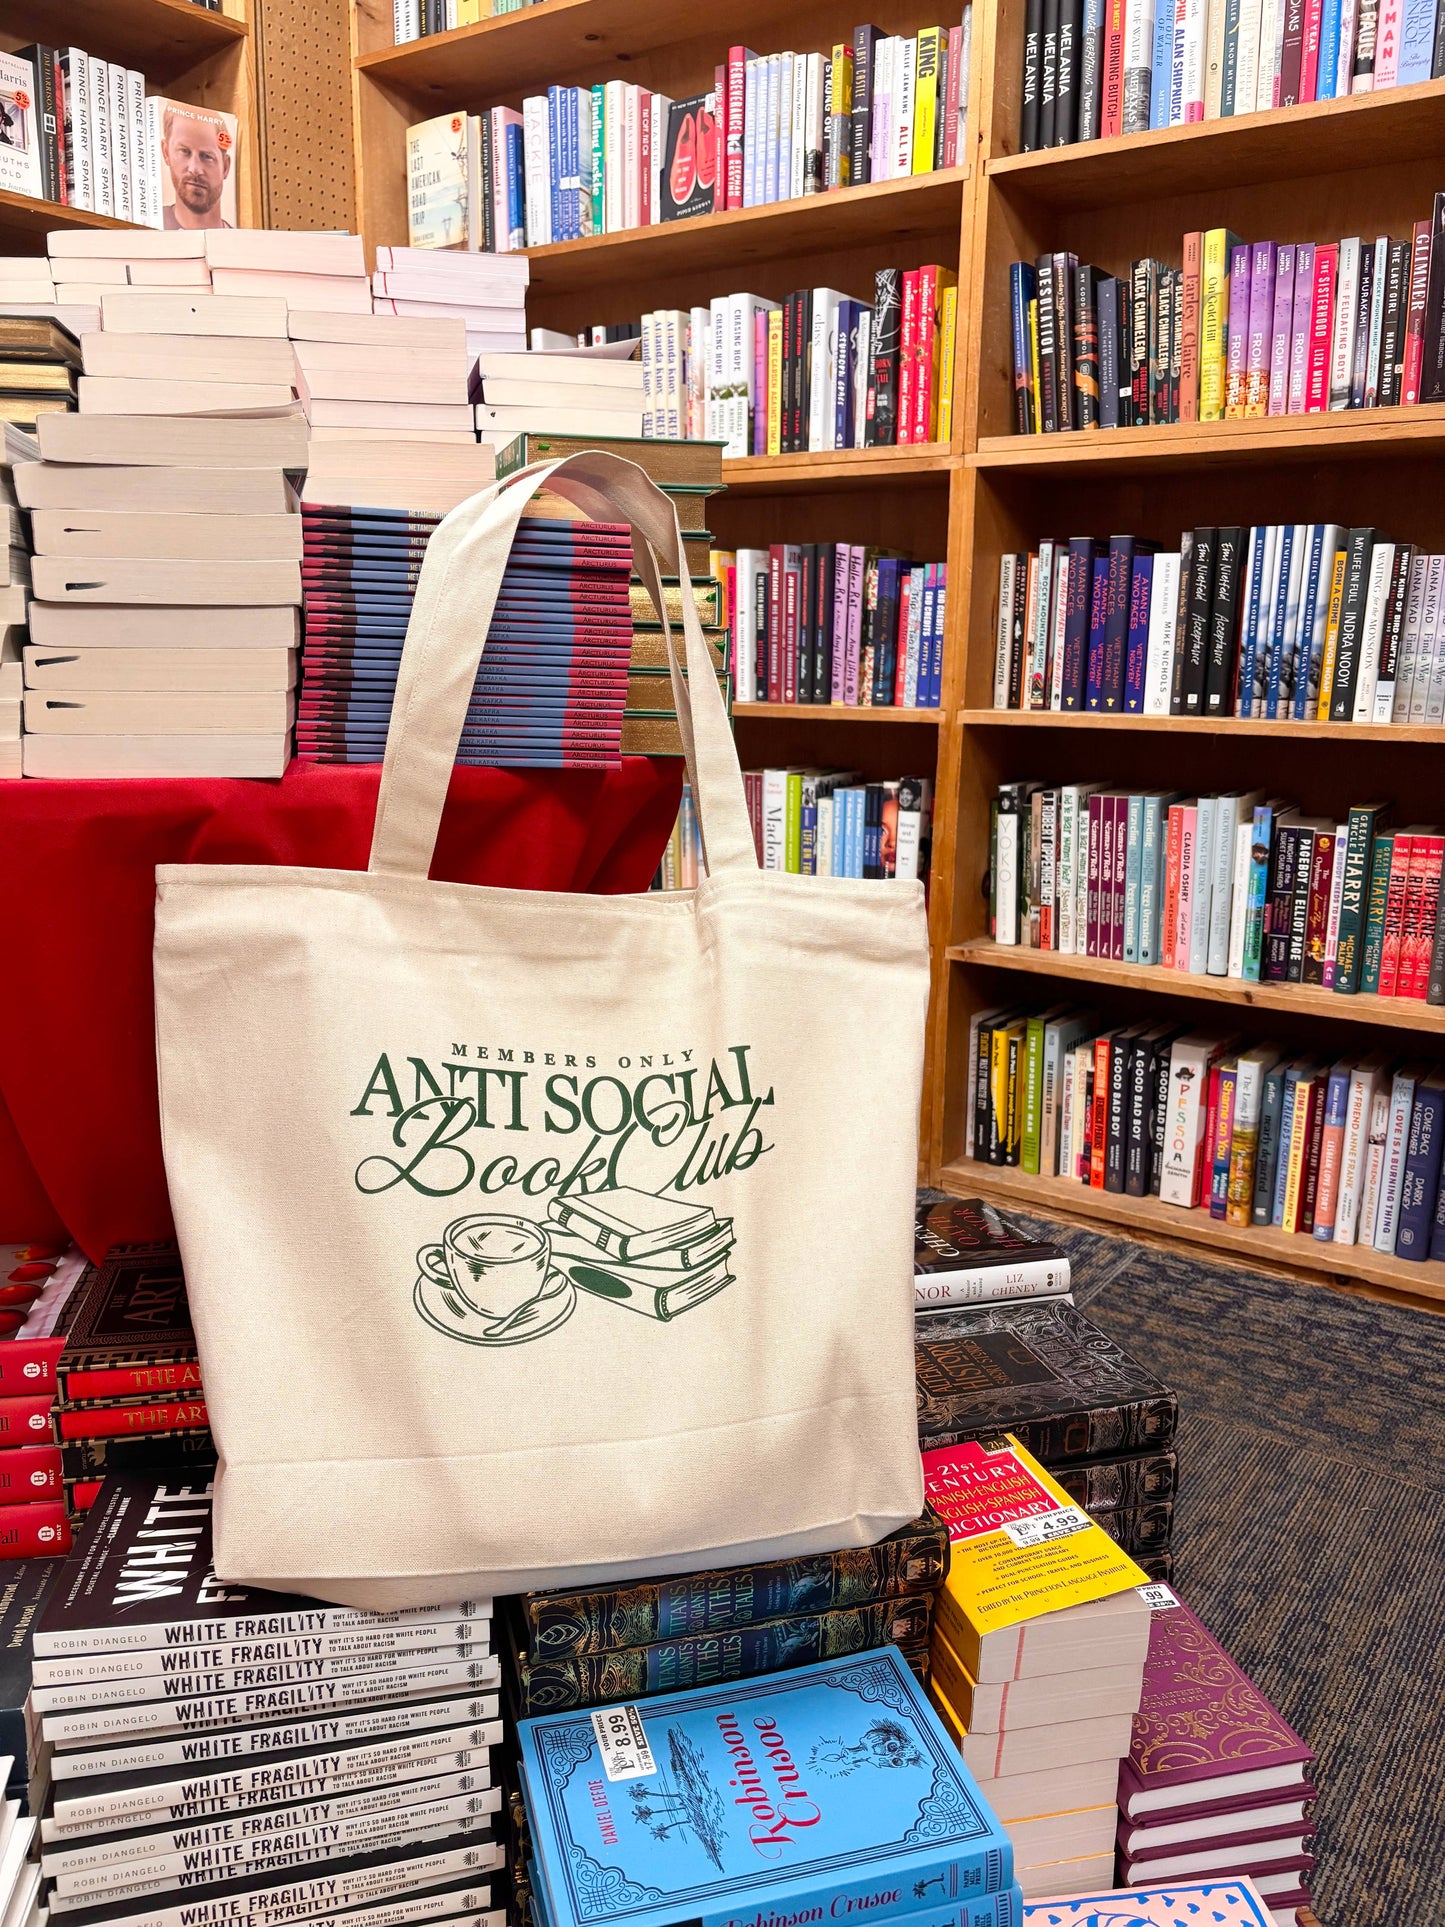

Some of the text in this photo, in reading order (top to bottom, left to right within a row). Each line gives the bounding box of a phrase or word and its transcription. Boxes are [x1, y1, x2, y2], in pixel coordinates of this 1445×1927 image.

[858, 46, 867, 68] LAST
[918, 34, 937, 79] KING
[1024, 32, 1038, 105] MELANIA
[1042, 32, 1056, 106] MELANIA
[1058, 24, 1072, 98] MELANIA
[1107, 34, 1120, 118] BURNING BUTCH
[1170, 28, 1186, 121] ALAN SHIPNUCK
[729, 61, 744, 138] PERSEVERANCE
[855, 70, 866, 98] CASTLE
[77, 57, 90, 199] PRINCE HARRY SPARE
[166, 105, 225, 126] PRINCE HARRY
[899, 126, 908, 150] ALL
[898, 153, 906, 168] IN
[1410, 234, 1431, 312] GLIMMER
[1038, 268, 1054, 356] DESOLATION
[1134, 268, 1146, 362] BLACK CHAMELEON
[1338, 294, 1350, 348] FELDAFING
[1358, 277, 1370, 328] MURAKAMI
[1382, 246, 1401, 396] THE LAST GIRL NADIA MURAD
[1312, 260, 1330, 399] THE SISTERHOOD LIZA MUNDY
[1229, 335, 1242, 404] FROM HERE
[1336, 351, 1347, 380] BOYS
[583, 548, 619, 556] ARCTURUS
[1198, 543, 1210, 561] Emi
[1336, 560, 1344, 586] BORN
[1348, 537, 1364, 604] MY LIFE IN FULL
[834, 552, 847, 606] Holler Rat
[1408, 558, 1424, 624] DIANA NYAD
[998, 560, 1012, 685] SAVING FIVE AMANDA NGUYEN
[1330, 596, 1340, 624] CRIME
[1386, 552, 1410, 674] WHAT KIND OF BIRD CAN'T FLY
[1160, 621, 1172, 694] MIKE NICHOLS
[1190, 613, 1206, 666] Acceptance
[1337, 612, 1356, 688] INDRA NOOYI
[1358, 815, 1368, 852] GREAT-
[1182, 832, 1192, 902] CLAUDIA OSHRY
[1342, 817, 1364, 914] UNCLE HARRY
[1290, 838, 1312, 961] PAGEBOY ELLIOT PAGE
[1384, 876, 1406, 938] RIVERINE
[1338, 942, 1346, 966] PALIN
[1343, 934, 1355, 974] MICHAEL
[450, 1042, 696, 1069] MEMBERS ONLY
[350, 1044, 775, 1136] ANTI SOCIAL
[1110, 1046, 1124, 1138] A GOOD BAD BOY
[1216, 1080, 1234, 1160] Shame on You
[1345, 1080, 1364, 1190] MY FRIEND ANNE FRANK
[1394, 1108, 1405, 1134] LOVE
[1394, 1136, 1402, 1148] IS
[1408, 1101, 1423, 1156] IN SEPTEMBER
[1419, 1106, 1435, 1156] COME BACK
[355, 1096, 776, 1198] Book Club
[1386, 1158, 1399, 1202] BURNING
[1402, 1170, 1414, 1210] PINCKNEY
[1412, 1177, 1424, 1206] DARRYL
[1382, 1202, 1394, 1234] THING
[991, 1283, 1038, 1297] CHENEY
[1006, 1273, 1024, 1284] LIZ
[130, 1368, 176, 1389] THE
[924, 1462, 1018, 1494] ENTURY
[936, 1462, 976, 1476] 21ST
[1034, 1507, 1075, 1522] YOUR PRICE
[1043, 1514, 1080, 1531] 4.99
[112, 1486, 214, 1606] WHITE
[977, 1602, 1002, 1614] EDITED
[1002, 1598, 1010, 1606] BY
[1023, 1582, 1062, 1600] PRINCETON
[1062, 1574, 1098, 1587] LANGUAGE
[1098, 1564, 1128, 1578] INSTITUTE
[53, 1612, 326, 1650] ROBIN DIANGELO WHITE FRAGILITY
[416, 1628, 437, 1636] PEOPLE
[49, 1638, 323, 1678] ROBIN DIANGELO WHITE FRAGILITY
[595, 1714, 610, 1751] YOUR PRICE
[608, 1714, 631, 1747] 8.99
[716, 1712, 797, 1860] Robinson
[752, 1715, 822, 1828] Crusoe
[587, 1778, 620, 1845] DANIEL DEFOE
[830, 1888, 902, 1918] Crusoe
